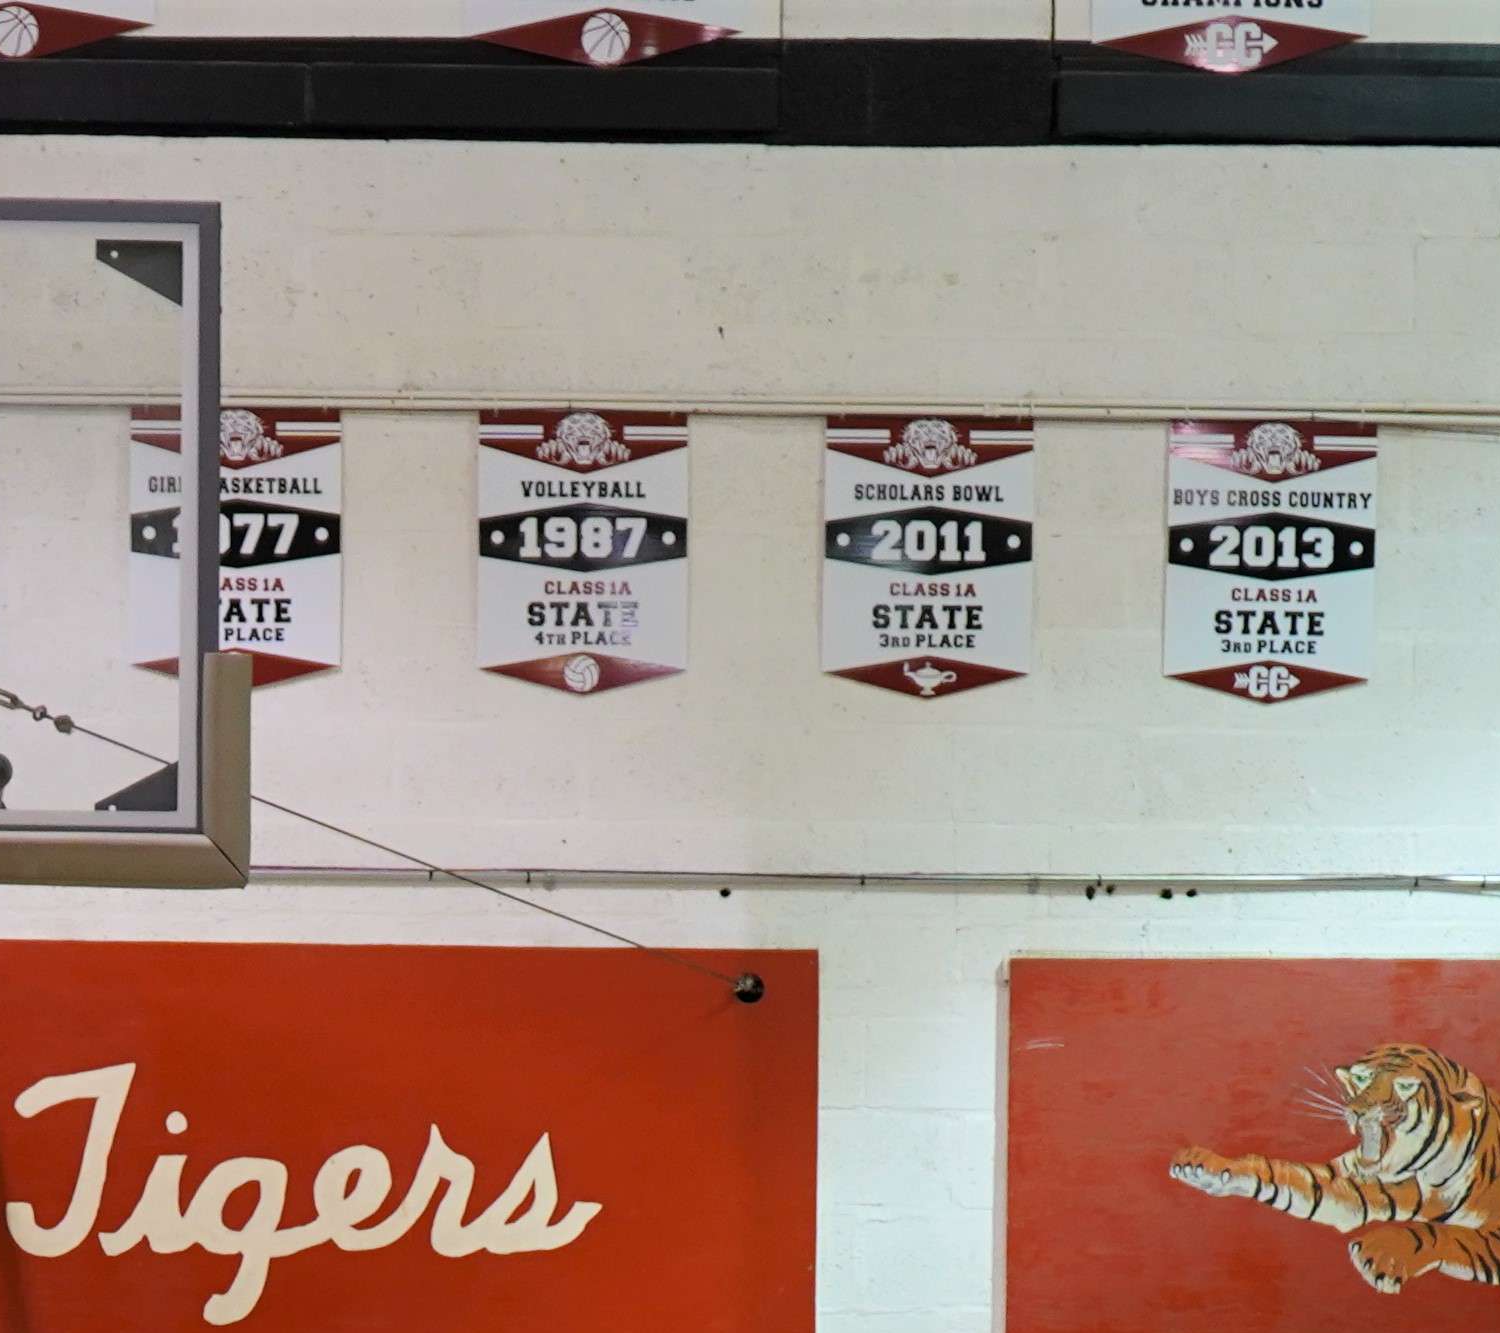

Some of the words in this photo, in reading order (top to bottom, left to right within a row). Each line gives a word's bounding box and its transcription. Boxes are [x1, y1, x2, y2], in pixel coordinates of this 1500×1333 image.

[521, 481, 646, 499] VOLLEYBALL
[854, 484, 945, 502] SCHOLARS
[952, 485, 1005, 503] BOWL
[1173, 489, 1221, 507] BOYS
[1226, 489, 1282, 508] CROSS
[1288, 490, 1373, 510] COUNTRY
[519, 517, 647, 559] 1987
[869, 520, 987, 563] 2011
[1208, 526, 1336, 569] 2013
[263, 577, 285, 592] 1A
[544, 581, 606, 596] CLASS
[609, 581, 632, 596] 1A
[889, 582, 951, 597] CLASS
[955, 582, 977, 598] 1A
[1231, 588, 1293, 603] CLASS
[1296, 589, 1318, 604] 1A
[527, 602, 640, 628] STATE
[871, 604, 984, 630] STATE
[1213, 610, 1326, 636] STATE
[224, 627, 285, 642] PLACE
[915, 634, 976, 649] PLACE
[1257, 640, 1317, 655] PLACE
[5, 1062, 603, 1326] Tigers
